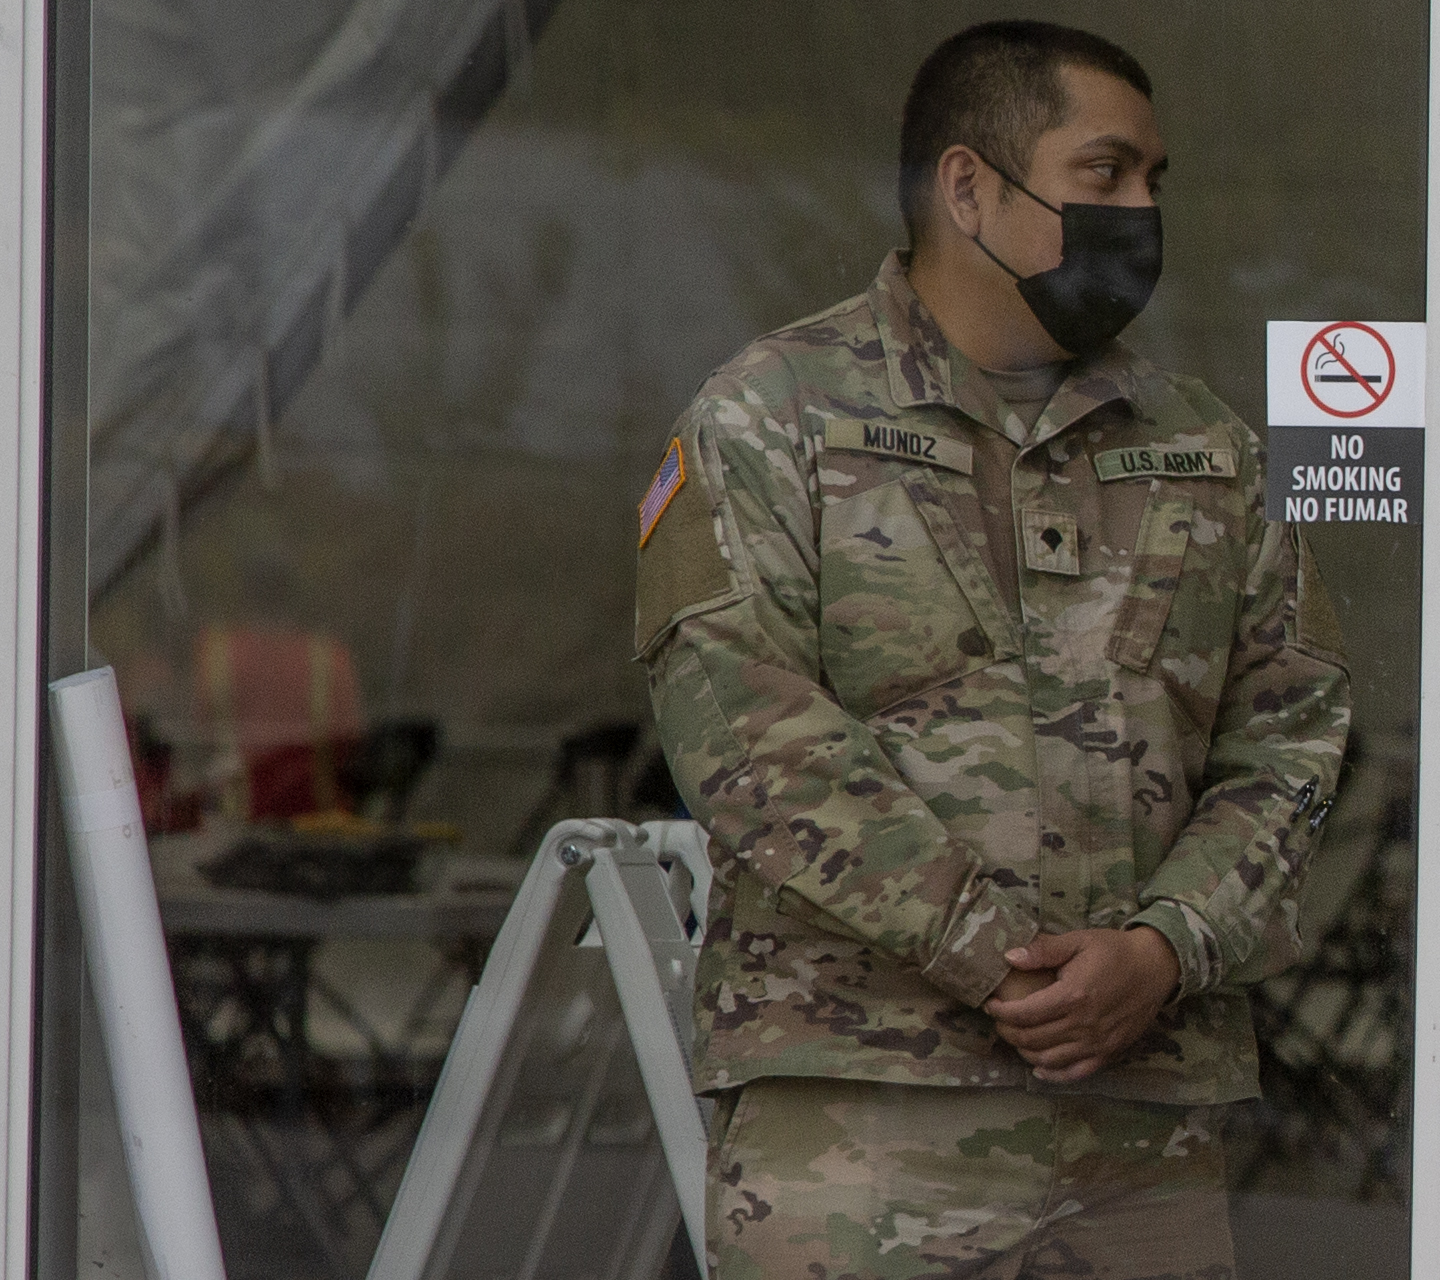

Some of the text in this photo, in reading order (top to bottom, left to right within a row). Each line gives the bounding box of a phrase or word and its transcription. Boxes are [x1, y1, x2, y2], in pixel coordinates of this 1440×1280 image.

[863, 424, 937, 461] MUNOZ
[1331, 435, 1364, 460] NO
[1120, 451, 1214, 473] U.S. ARMY
[1292, 465, 1401, 492] SMOKING
[1286, 497, 1407, 523] NO FUMAR
